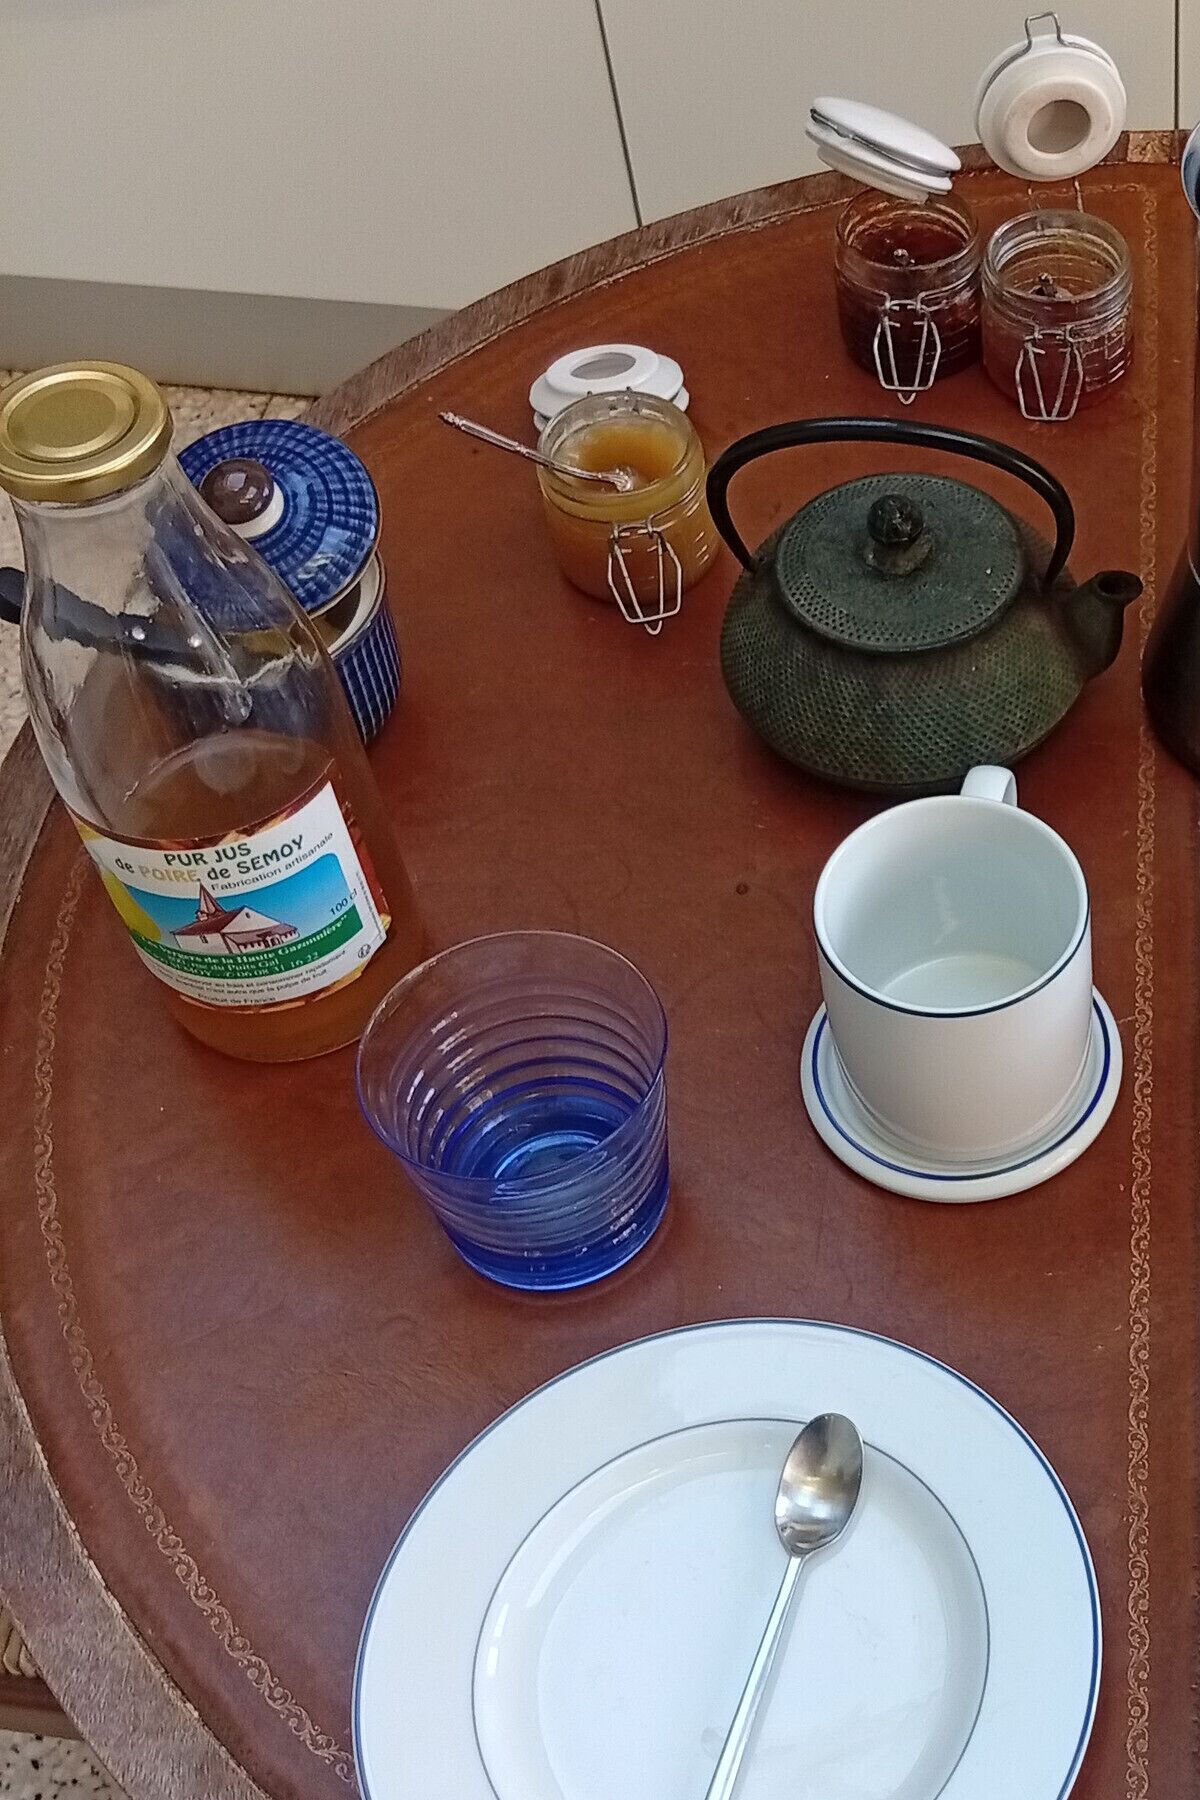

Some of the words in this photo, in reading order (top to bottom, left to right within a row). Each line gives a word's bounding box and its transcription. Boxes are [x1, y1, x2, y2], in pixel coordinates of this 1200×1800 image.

[114, 857, 135, 874] de
[138, 864, 198, 882] POIRE
[206, 866, 231, 881] de
[236, 834, 304, 875] SEMOY
[163, 852, 209, 867] PUR
[213, 842, 252, 863] JUS
[211, 867, 282, 892] Fabrication
[284, 832, 333, 870] artisanale
[330, 898, 348, 915] 100
[349, 888, 358, 900] cl
[236, 951, 276, 962] Haute
